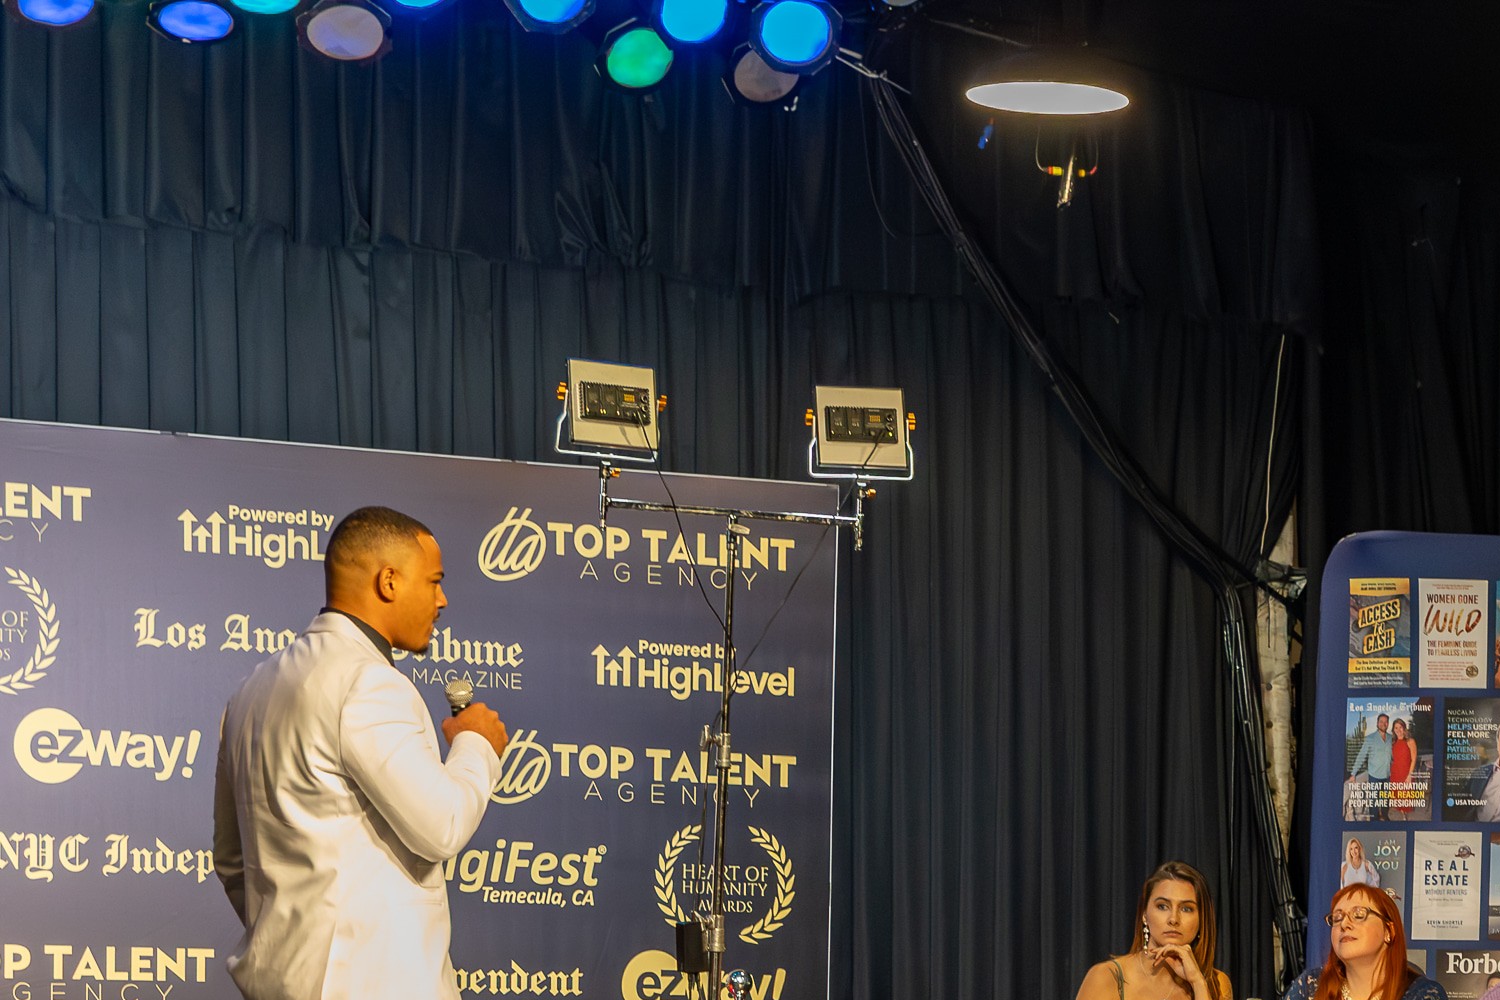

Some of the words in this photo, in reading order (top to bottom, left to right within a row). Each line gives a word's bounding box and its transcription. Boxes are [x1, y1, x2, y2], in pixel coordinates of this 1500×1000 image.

[229, 505, 307, 525] Powered
[311, 509, 334, 532] by
[229, 529, 326, 569] HighL
[547, 522, 630, 559] TOP
[1427, 594, 1456, 604] WOMEN
[1, 609, 29, 628] OF
[1423, 604, 1482, 636] WILD
[134, 608, 207, 650] Los
[639, 639, 712, 659] Powered
[412, 667, 523, 690] MAGAZINE
[638, 658, 795, 701] HighLevel
[1472, 723, 1498, 731] USERS
[14, 712, 201, 783] ezway!
[553, 743, 634, 783] TOP
[1361, 782, 1382, 790] GREAT
[1383, 782, 1428, 790] RESIGNATION
[1379, 791, 1395, 799] REAL
[1397, 791, 1425, 799] REASON
[1348, 799, 1374, 808] PEOPLE
[1389, 799, 1426, 808] RESIGNING
[1374, 845, 1401, 856] JOY
[745, 865, 769, 882] OF
[1374, 860, 1399, 870] YOU
[1425, 860, 1469, 871] REAL
[1424, 874, 1468, 886] ESTATE
[482, 887, 567, 908] Temecula,
[571, 889, 596, 907] CA
[1425, 888, 1446, 896] WITHOUT
[44, 944, 215, 982] TALENT
[454, 959, 584, 998] pendent
